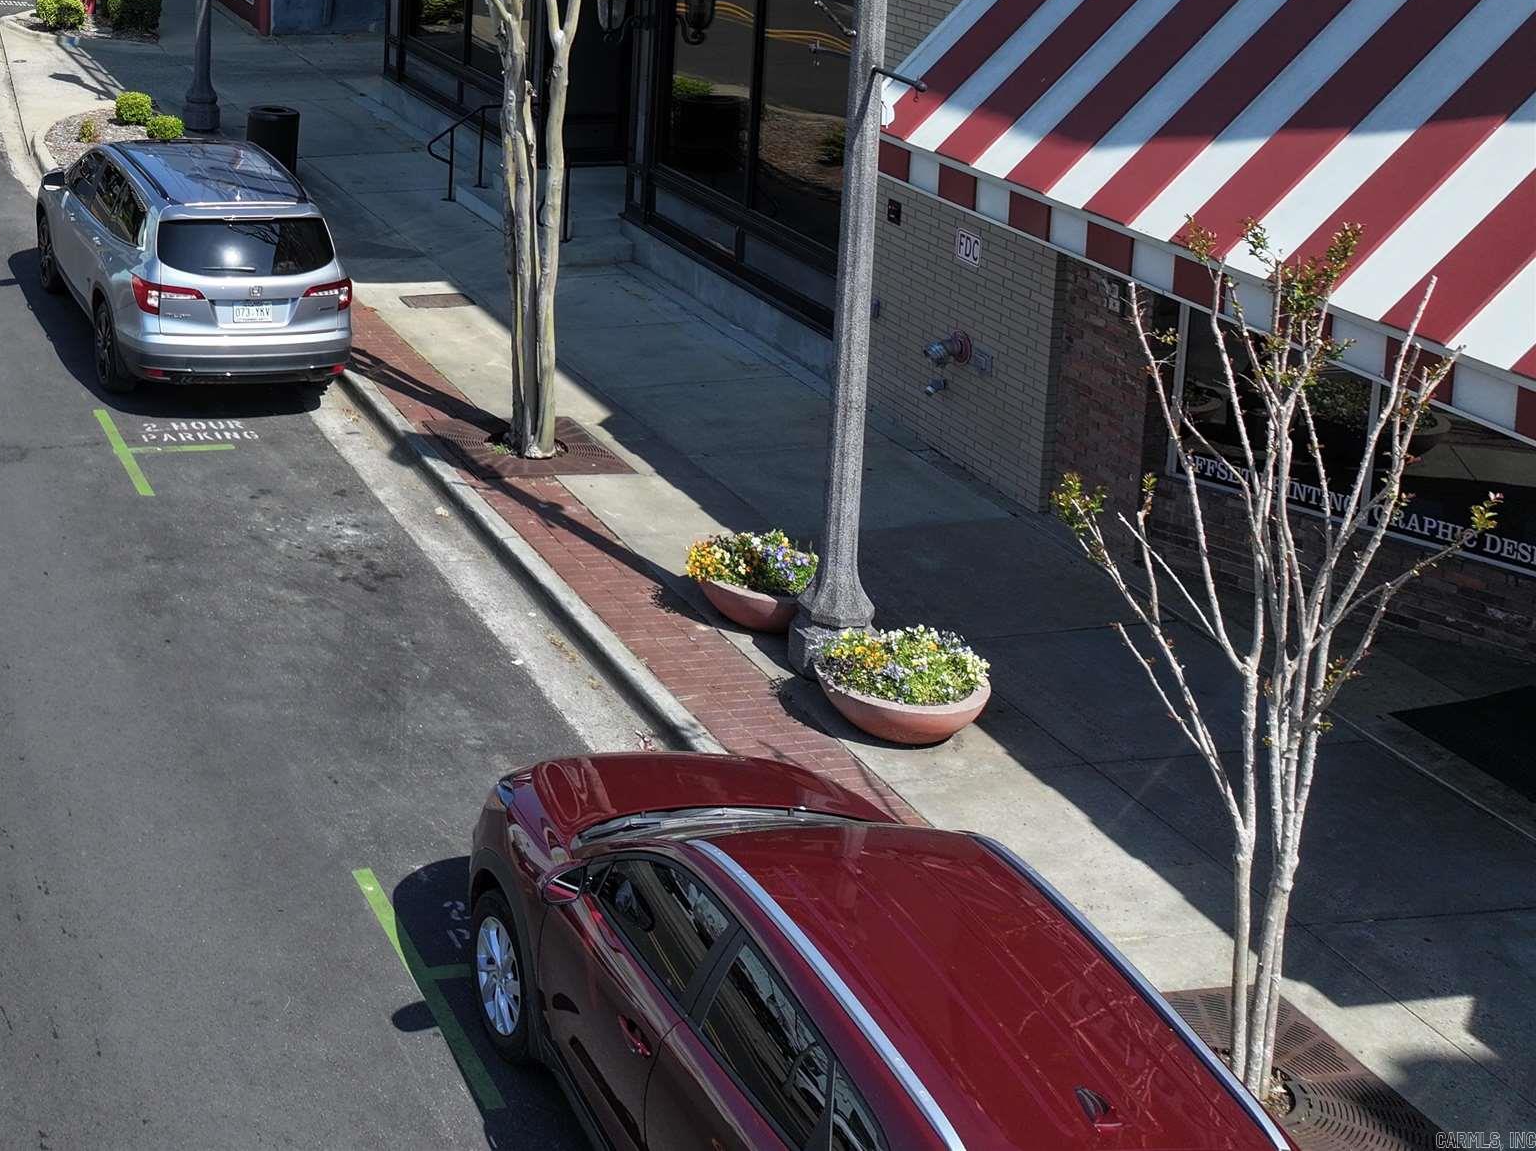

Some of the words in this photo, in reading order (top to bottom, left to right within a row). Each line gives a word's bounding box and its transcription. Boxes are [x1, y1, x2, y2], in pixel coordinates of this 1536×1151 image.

[959, 233, 979, 261] FDC
[142, 423, 160, 432] 2
[170, 420, 244, 431] HOUR
[141, 431, 259, 442] PARKING
[1188, 454, 1252, 485] FFSET
